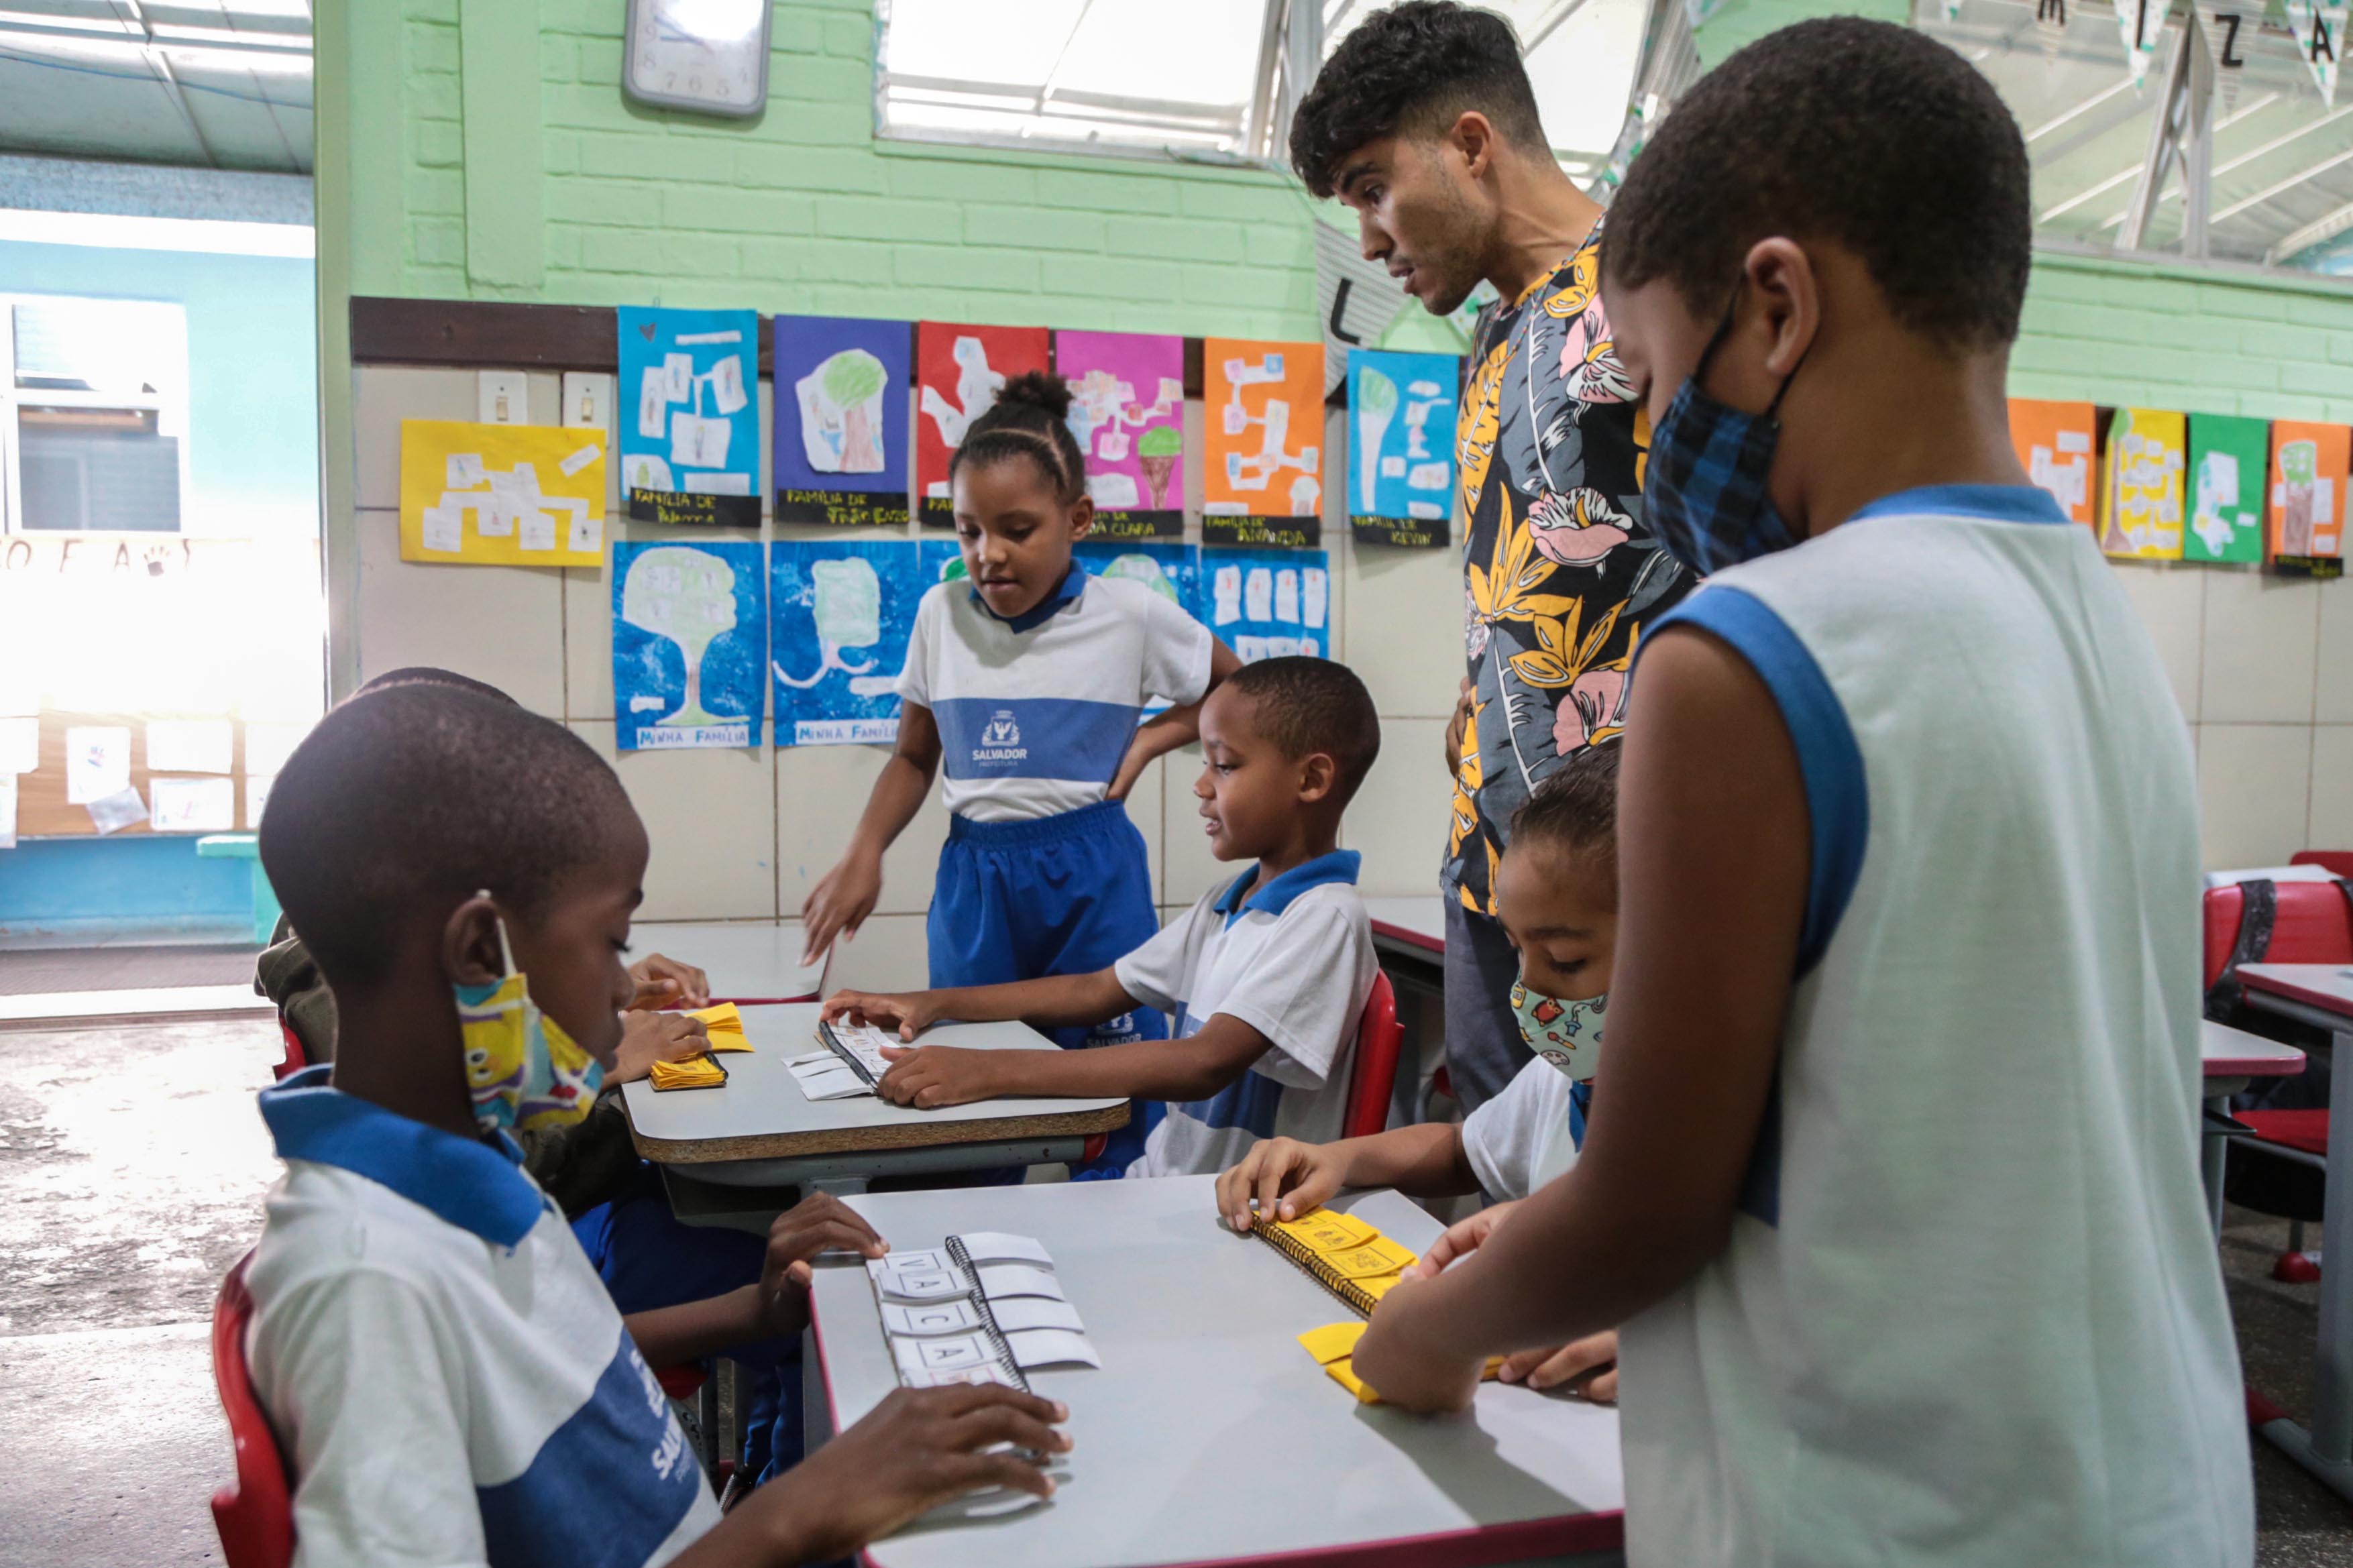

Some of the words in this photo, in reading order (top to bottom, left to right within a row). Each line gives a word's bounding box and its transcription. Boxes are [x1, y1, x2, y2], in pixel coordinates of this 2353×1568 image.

[696, 495, 716, 510] DE
[848, 494, 868, 506] DE
[972, 748, 1028, 761] SALVADOR
